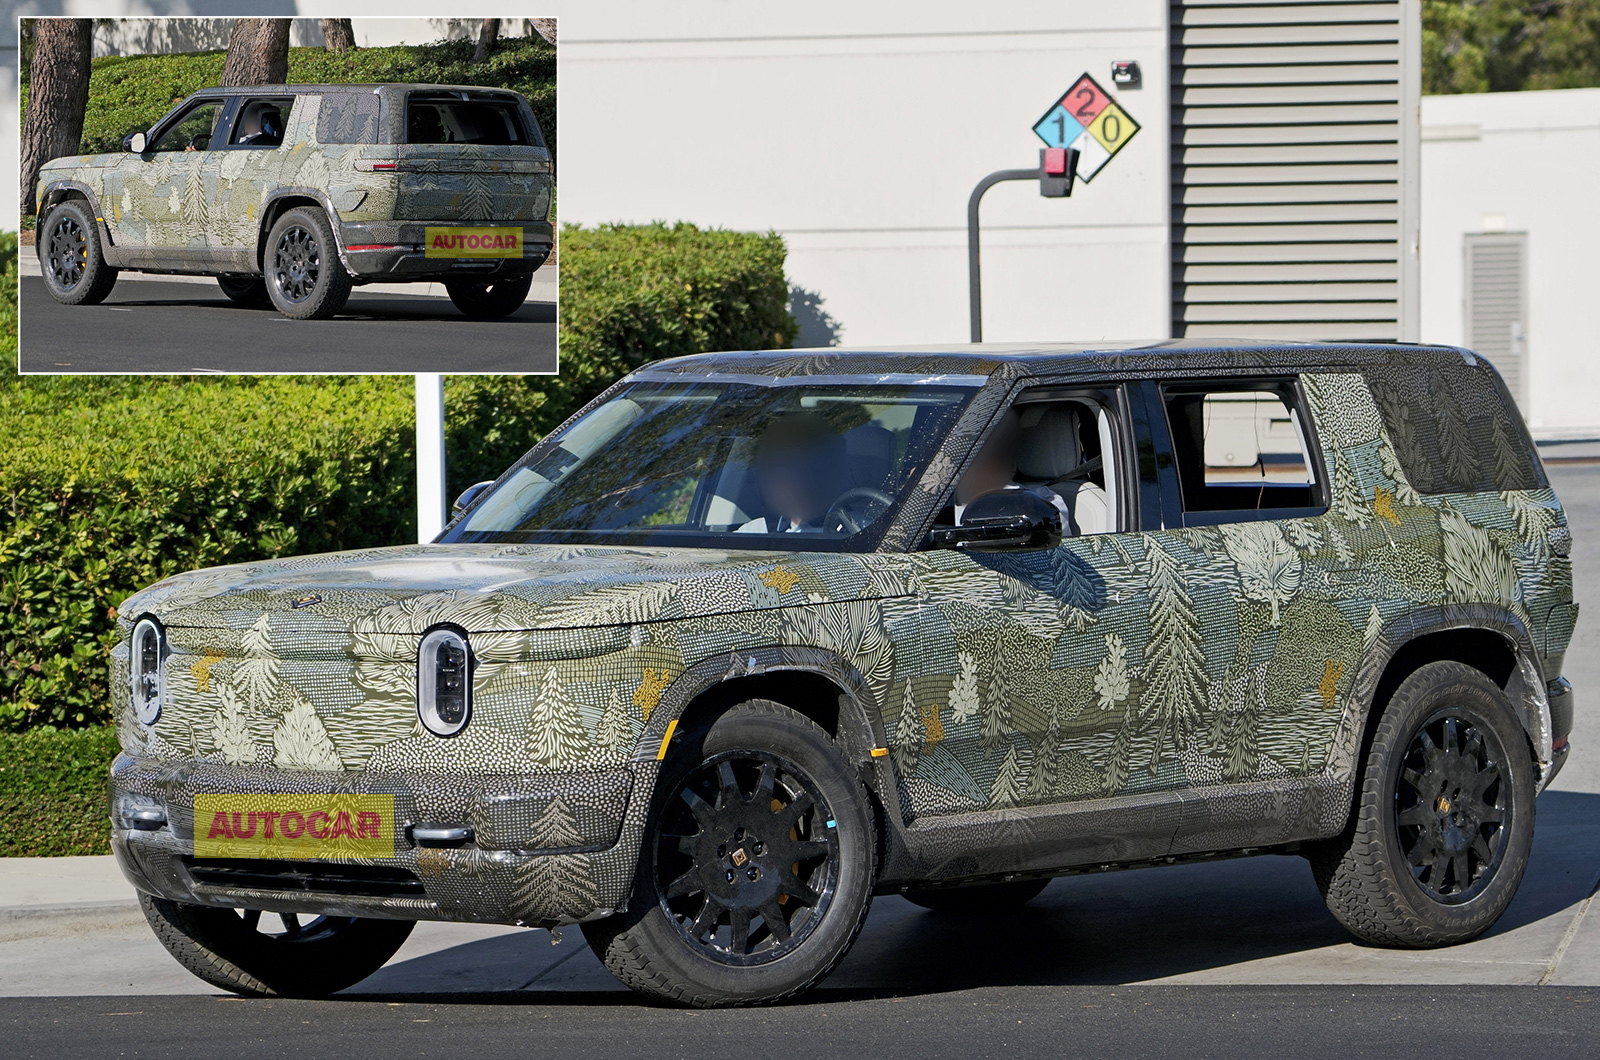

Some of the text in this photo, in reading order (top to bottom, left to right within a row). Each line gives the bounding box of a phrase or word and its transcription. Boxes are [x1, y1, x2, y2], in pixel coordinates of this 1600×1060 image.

[1076, 88, 1095, 117] 2
[1052, 115, 1065, 144] 1
[1102, 114, 1120, 143] 0
